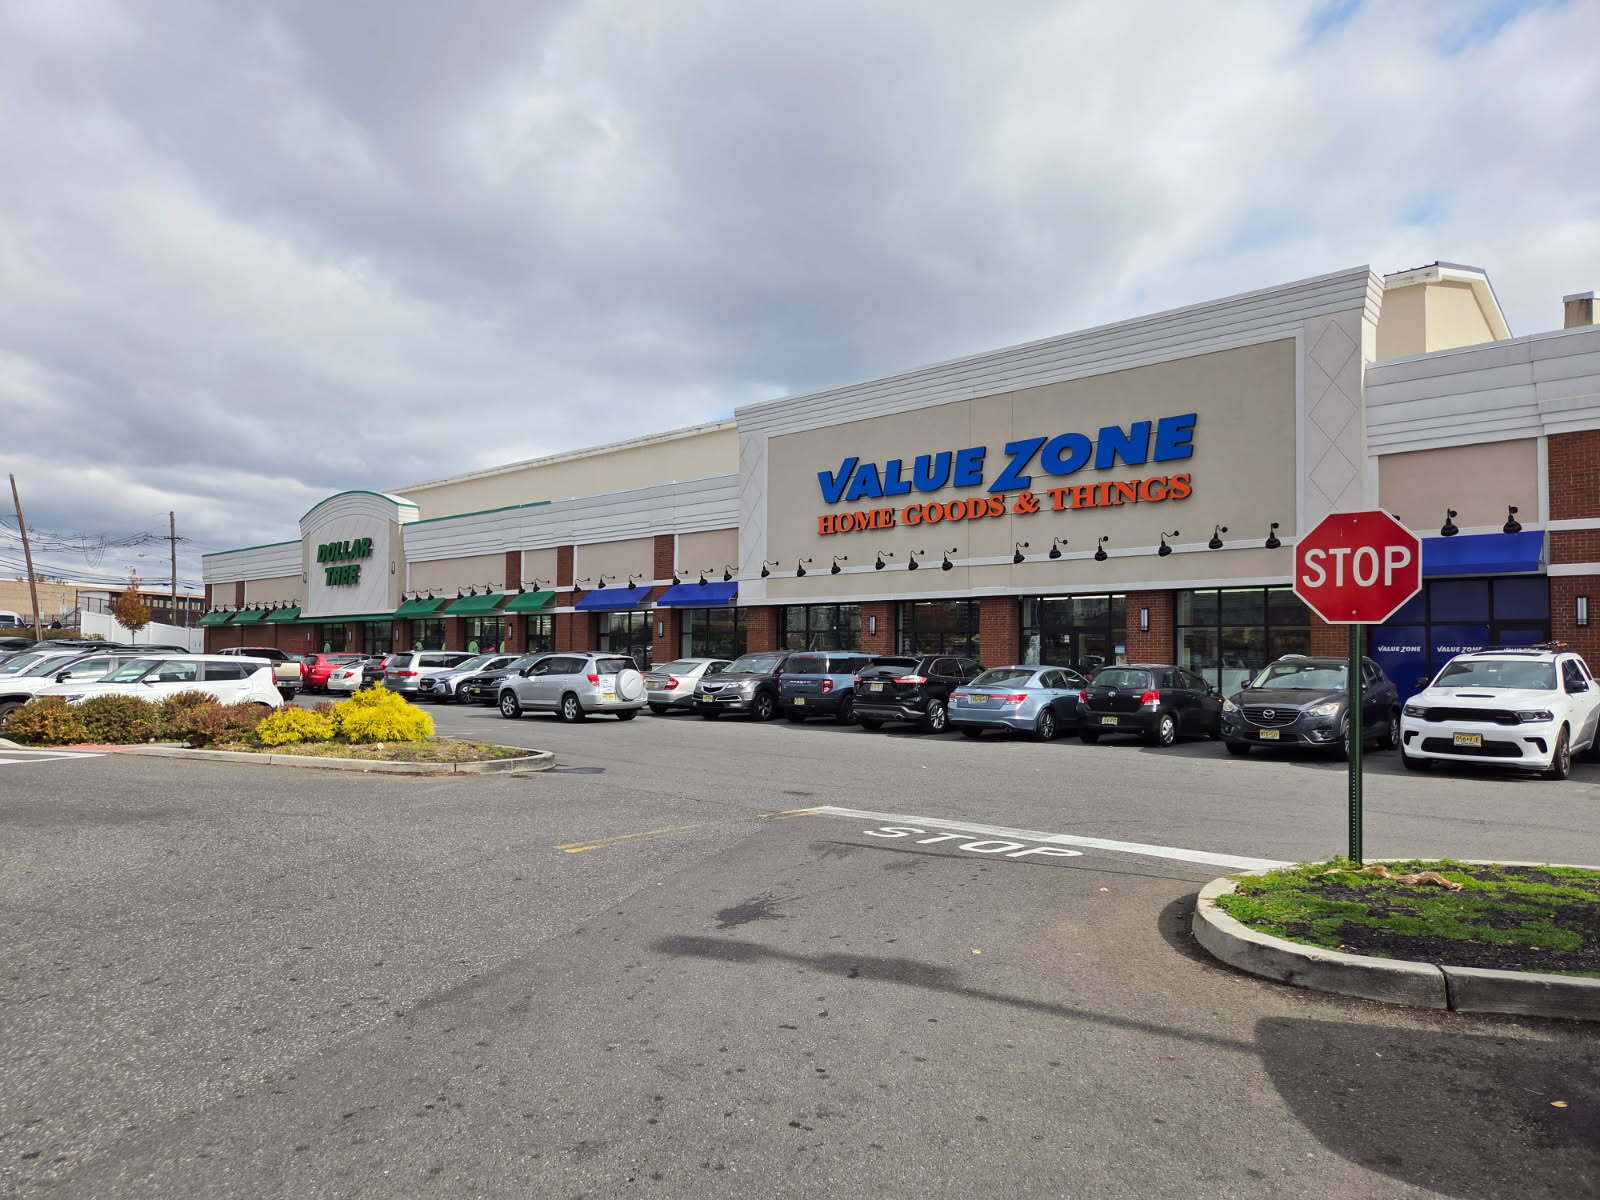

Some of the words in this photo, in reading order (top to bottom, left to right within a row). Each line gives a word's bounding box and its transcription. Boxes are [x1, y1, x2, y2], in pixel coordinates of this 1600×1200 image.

[817, 446, 986, 504] VALUE
[987, 413, 1198, 492] ZONE
[817, 508, 896, 535] HOME
[902, 494, 1006, 527] GOODS
[1012, 491, 1040, 515] &
[1047, 473, 1193, 511] THINGS
[317, 537, 373, 563] DOLLAR
[1302, 545, 1411, 588] STOP
[325, 564, 361, 586] TREE
[863, 827, 1084, 858] STOP
